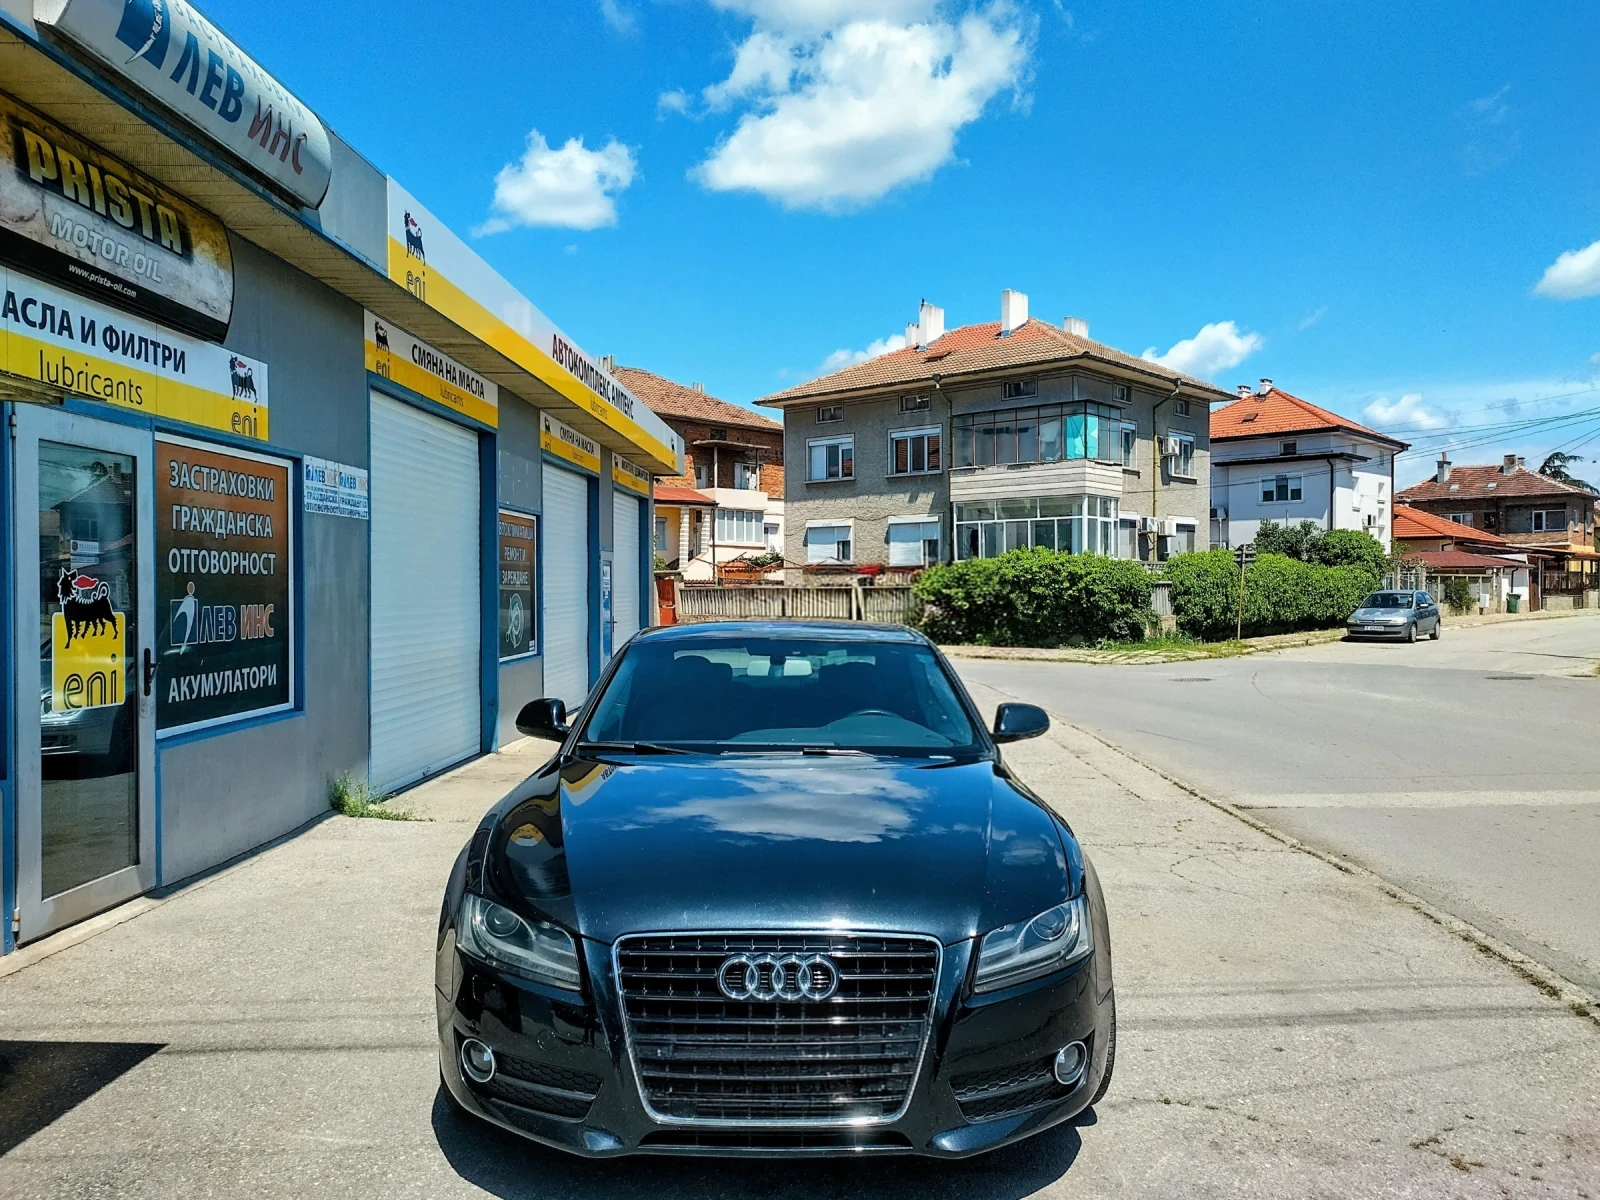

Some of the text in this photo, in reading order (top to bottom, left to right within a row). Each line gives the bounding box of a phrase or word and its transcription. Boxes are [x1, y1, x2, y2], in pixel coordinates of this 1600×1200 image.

[169, 30, 307, 176] ЛЕВ ИНС
[21, 126, 182, 255] PRISTA
[50, 213, 162, 283] MOTOR OIL
[68, 263, 137, 298] www.prista-oil.com
[406, 270, 425, 303] eni
[80, 316, 97, 347] И
[102, 324, 187, 375] ФИЛТРИ
[38, 350, 143, 406] lubricants
[376, 358, 390, 379] eni
[411, 343, 485, 399] СМЯНА НА МАСЛА
[552, 333, 611, 403] АВТОКОМПЛЕКС
[231, 407, 258, 438] eni
[169, 460, 275, 501] ЗАСТРАХОВКИ
[172, 504, 273, 540] ГРАЖДАНСКА
[168, 547, 276, 575] ОТГОВОРНОСТ
[199, 603, 274, 643] ЛЕВ ИНС
[63, 653, 117, 711] eni
[168, 664, 277, 703] АКУМУЛАТОРИ
